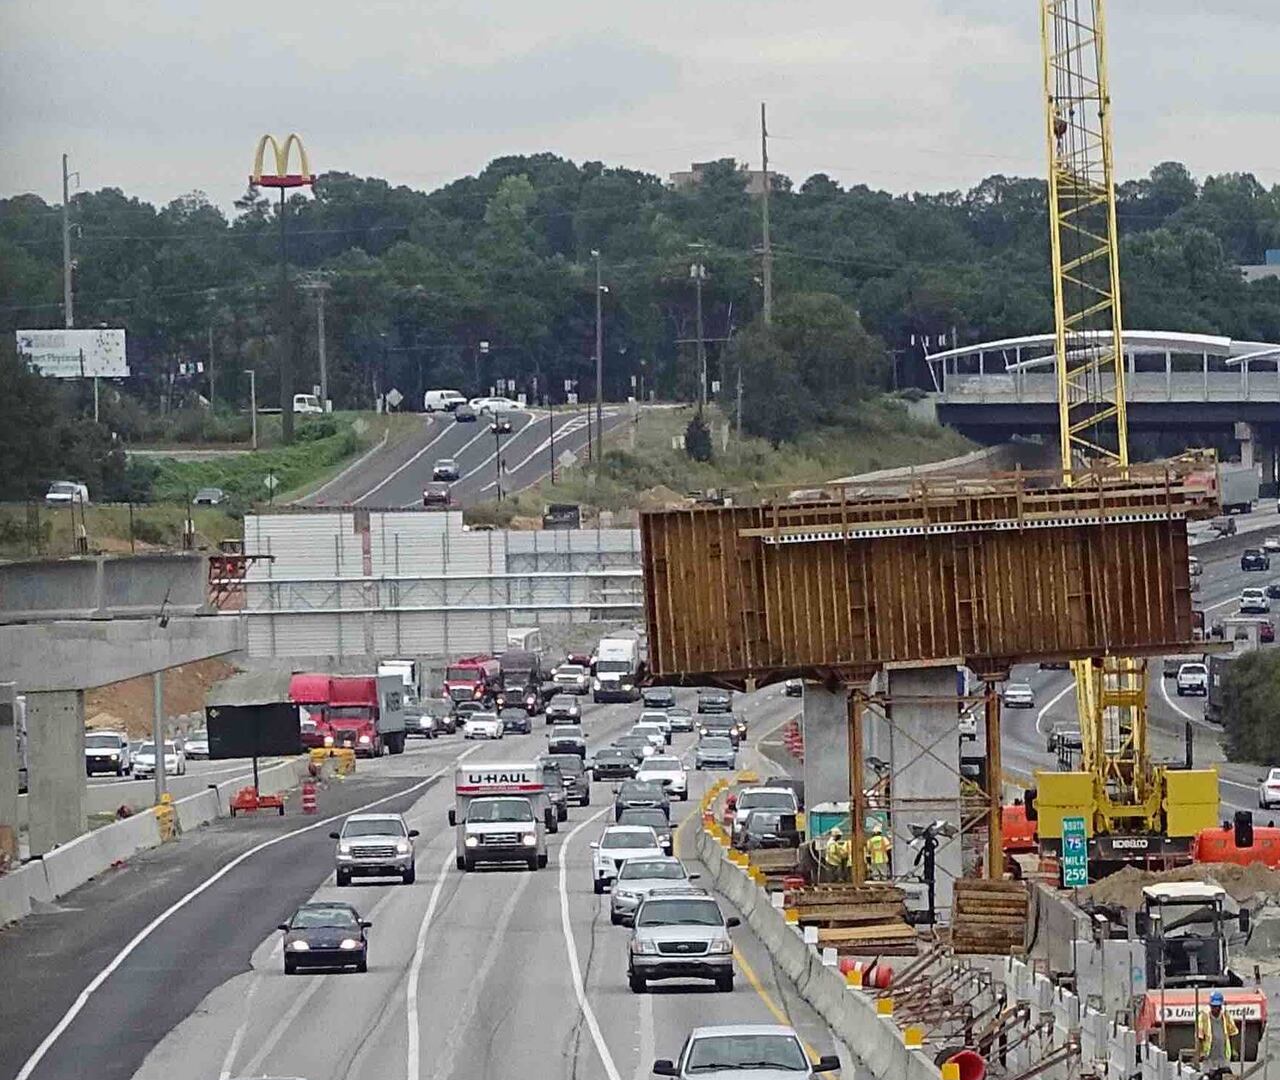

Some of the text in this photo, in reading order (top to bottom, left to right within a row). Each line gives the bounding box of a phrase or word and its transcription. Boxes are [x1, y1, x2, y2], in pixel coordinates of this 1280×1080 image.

[469, 773, 531, 784] U-HAUL
[1067, 838, 1082, 849] 75
[1112, 839, 1149, 849] KOBELCO
[1065, 856, 1086, 866] MILE
[1066, 868, 1086, 880] 259
